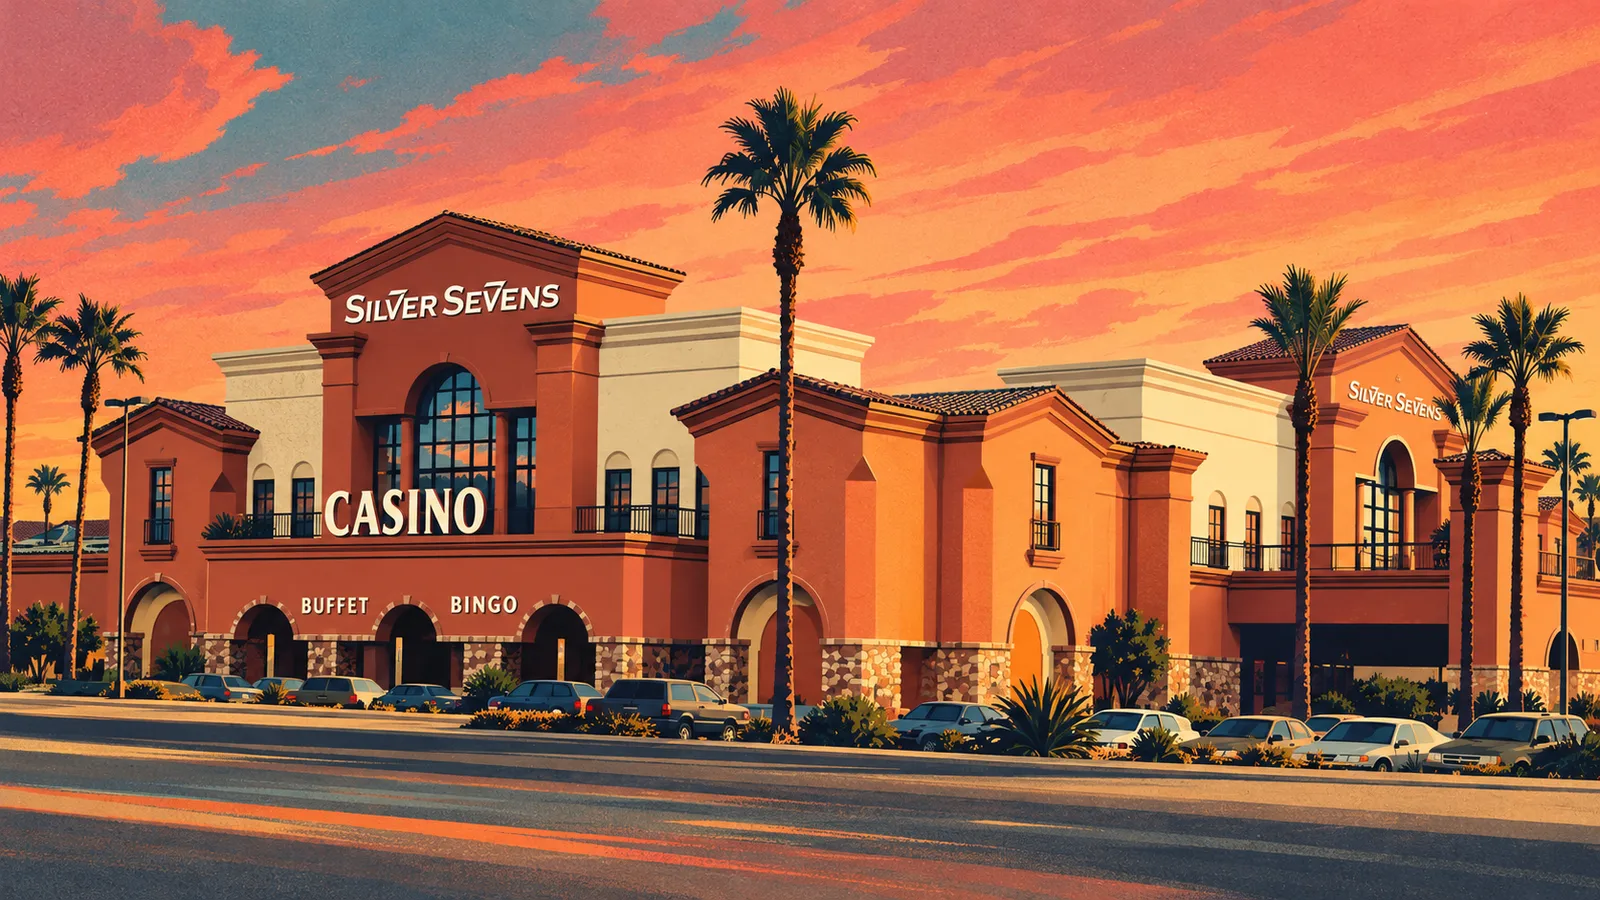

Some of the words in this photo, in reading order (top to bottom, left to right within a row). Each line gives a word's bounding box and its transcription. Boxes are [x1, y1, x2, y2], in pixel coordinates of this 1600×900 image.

[344, 288, 438, 324] SILVER
[442, 281, 560, 316] SEVENS
[1348, 380, 1393, 409] SILVER
[1395, 392, 1442, 421] SEVENS
[324, 487, 485, 536] CASINO
[301, 597, 369, 614] BUFFET
[450, 595, 518, 614] BINGO
